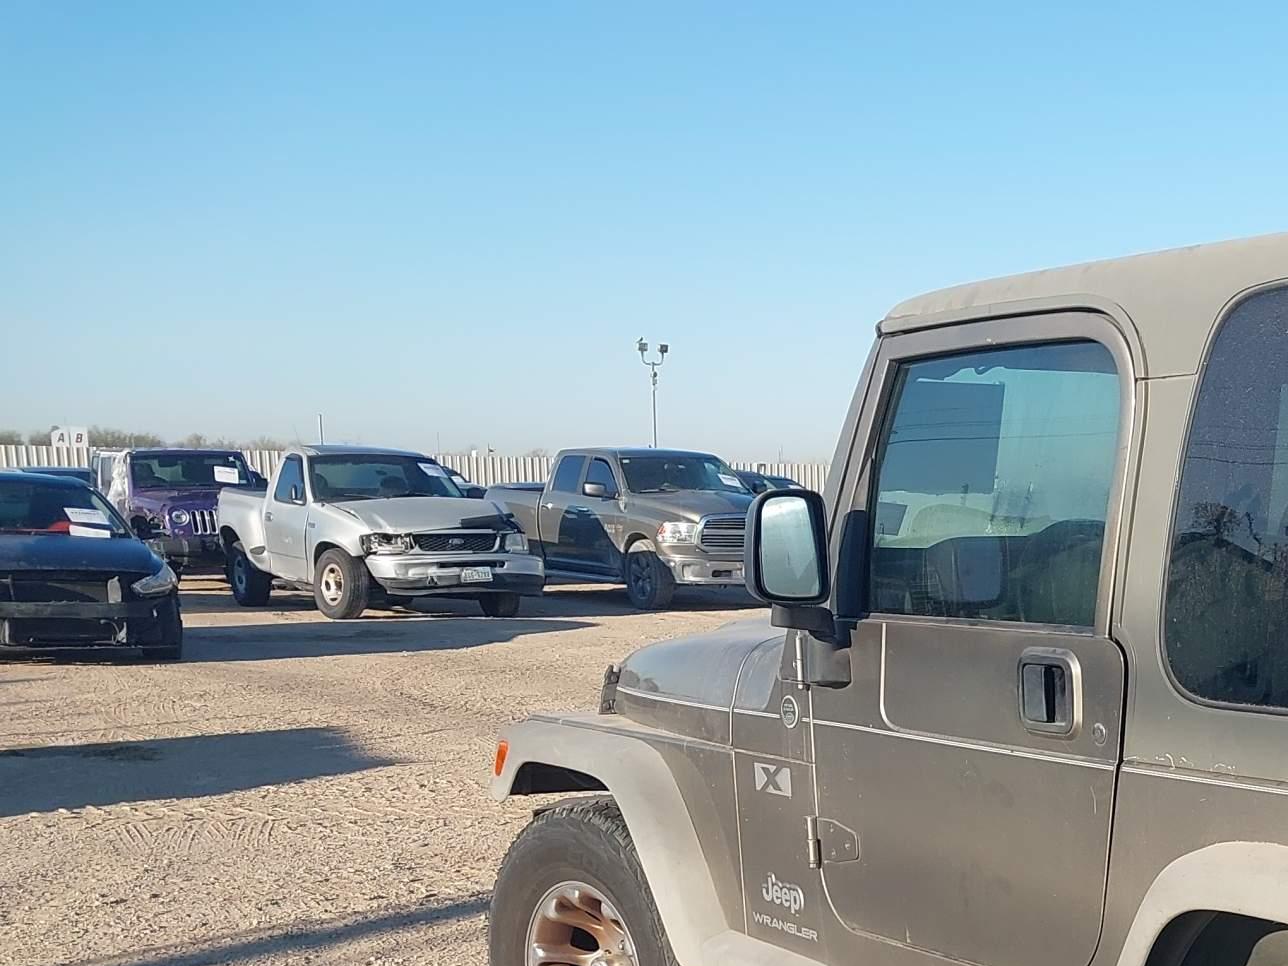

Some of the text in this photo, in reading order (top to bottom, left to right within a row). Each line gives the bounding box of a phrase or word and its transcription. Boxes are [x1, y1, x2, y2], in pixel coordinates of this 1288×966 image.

[57, 432, 83, 443] A B
[762, 873, 803, 914] Jeep
[753, 911, 818, 942] WRANGLER
